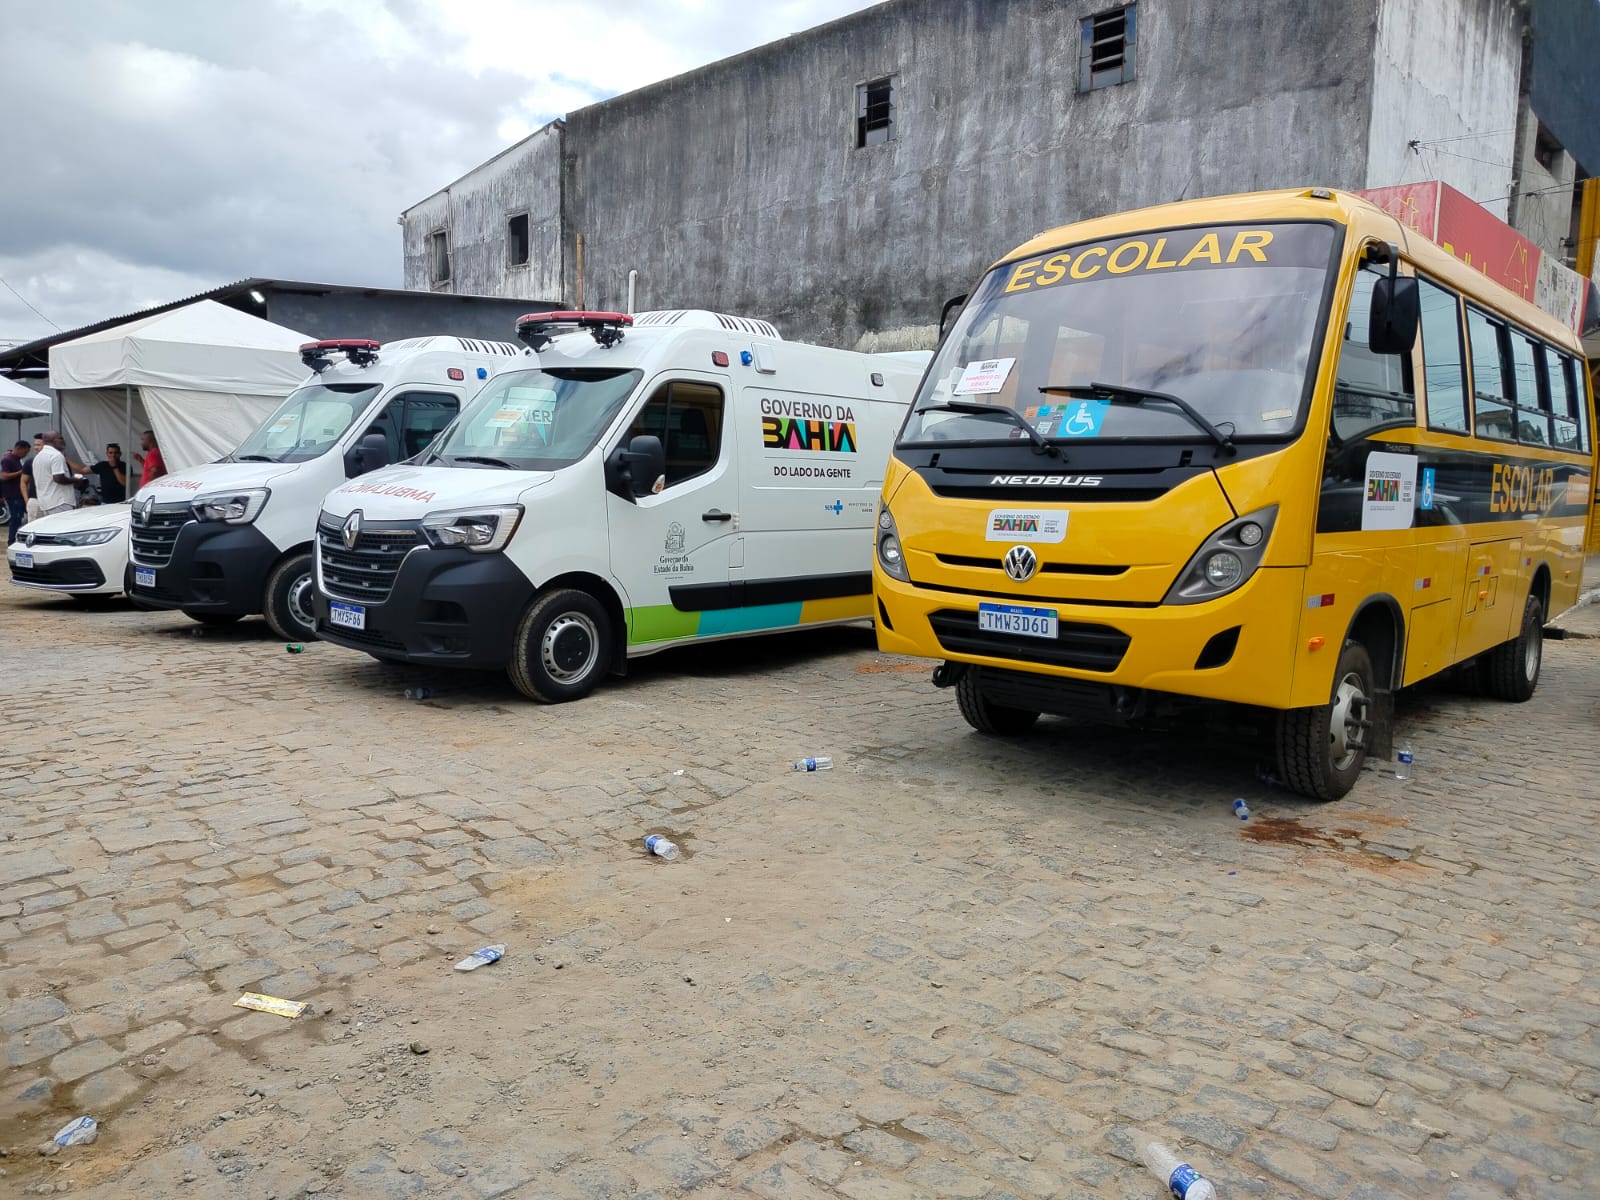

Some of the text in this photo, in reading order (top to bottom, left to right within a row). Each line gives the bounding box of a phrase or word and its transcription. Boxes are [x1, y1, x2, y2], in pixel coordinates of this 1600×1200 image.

[1004, 231, 1274, 293] ESCOLAR
[761, 398, 855, 421] GOVERNO DA
[762, 415, 857, 452] BAHIA
[774, 466, 851, 478] DO LADO DA GENTE
[990, 475, 1103, 486] NEOBUS
[1368, 479, 1402, 501] BAHIA
[1490, 464, 1554, 512] ESCOLAR
[993, 519, 1039, 532] BAHIA
[986, 612, 1049, 634] TMW3D60
